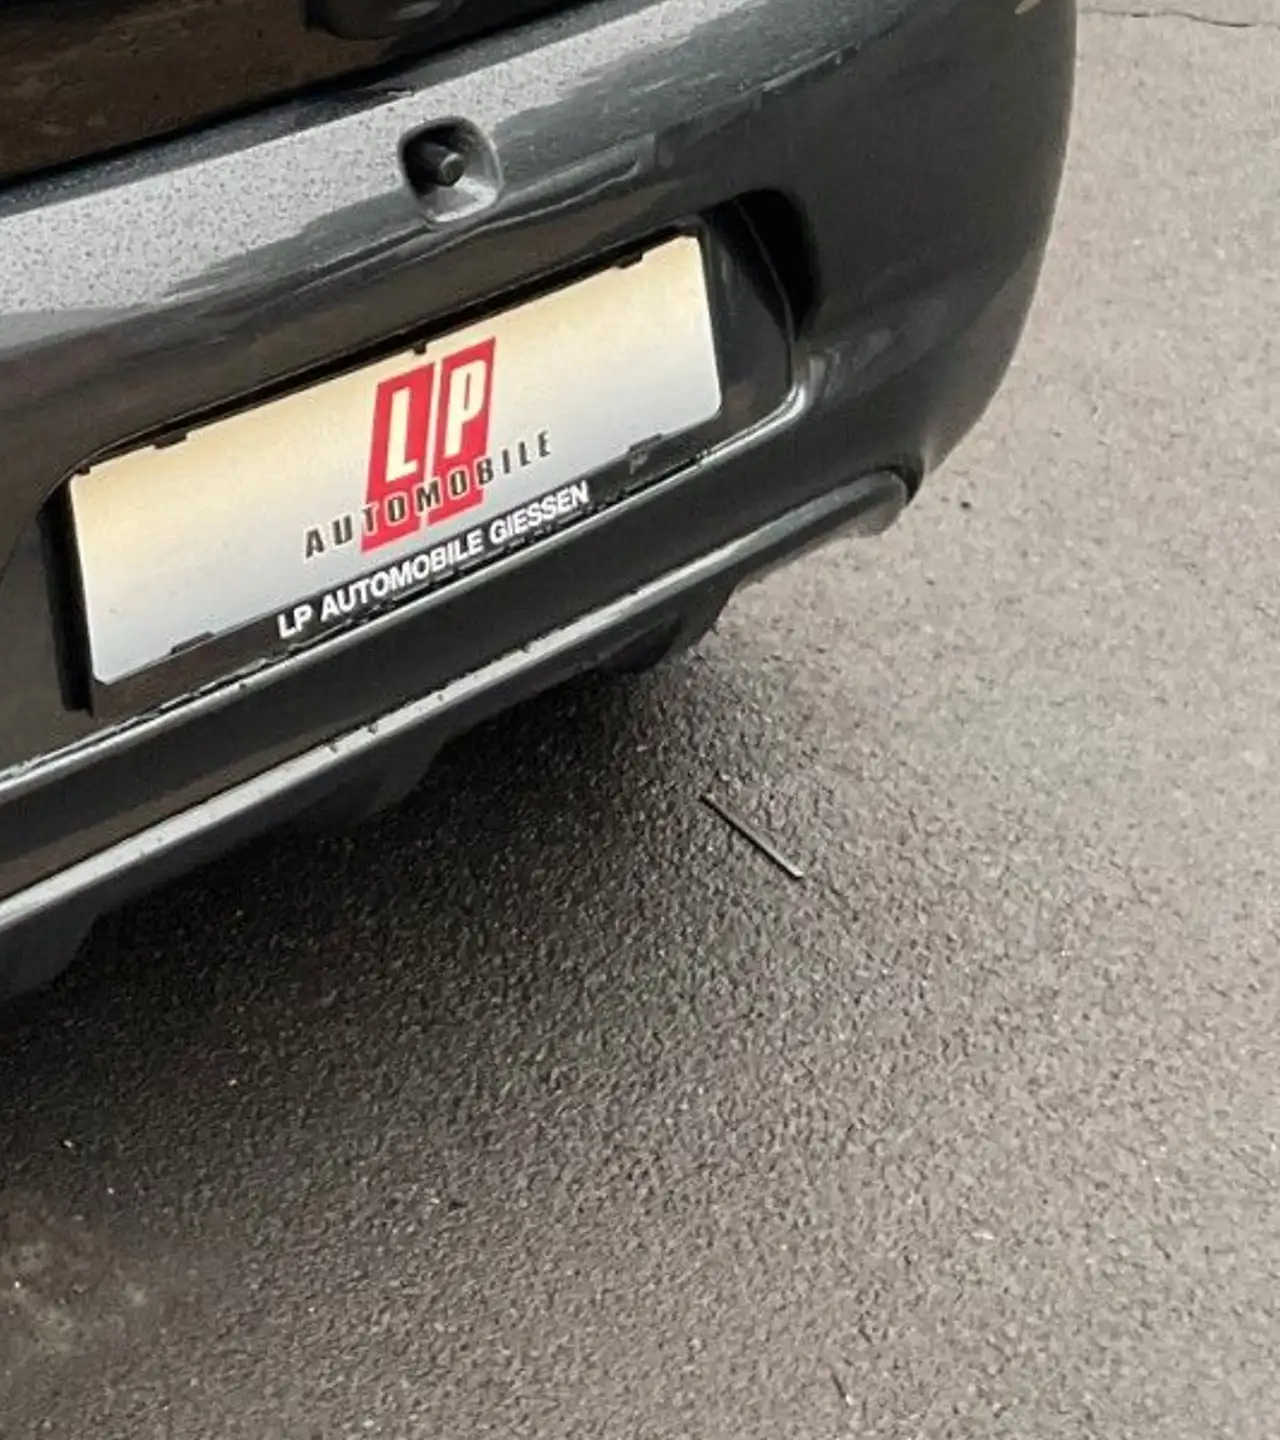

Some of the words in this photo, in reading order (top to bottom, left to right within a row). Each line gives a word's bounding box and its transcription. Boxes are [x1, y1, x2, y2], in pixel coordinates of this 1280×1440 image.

[383, 358, 490, 484] LP
[277, 602, 313, 639] LP
[320, 527, 485, 621] AUTOMOBILE
[489, 479, 590, 544] GIESSEN
[304, 428, 552, 559] AUTOMOBILE
